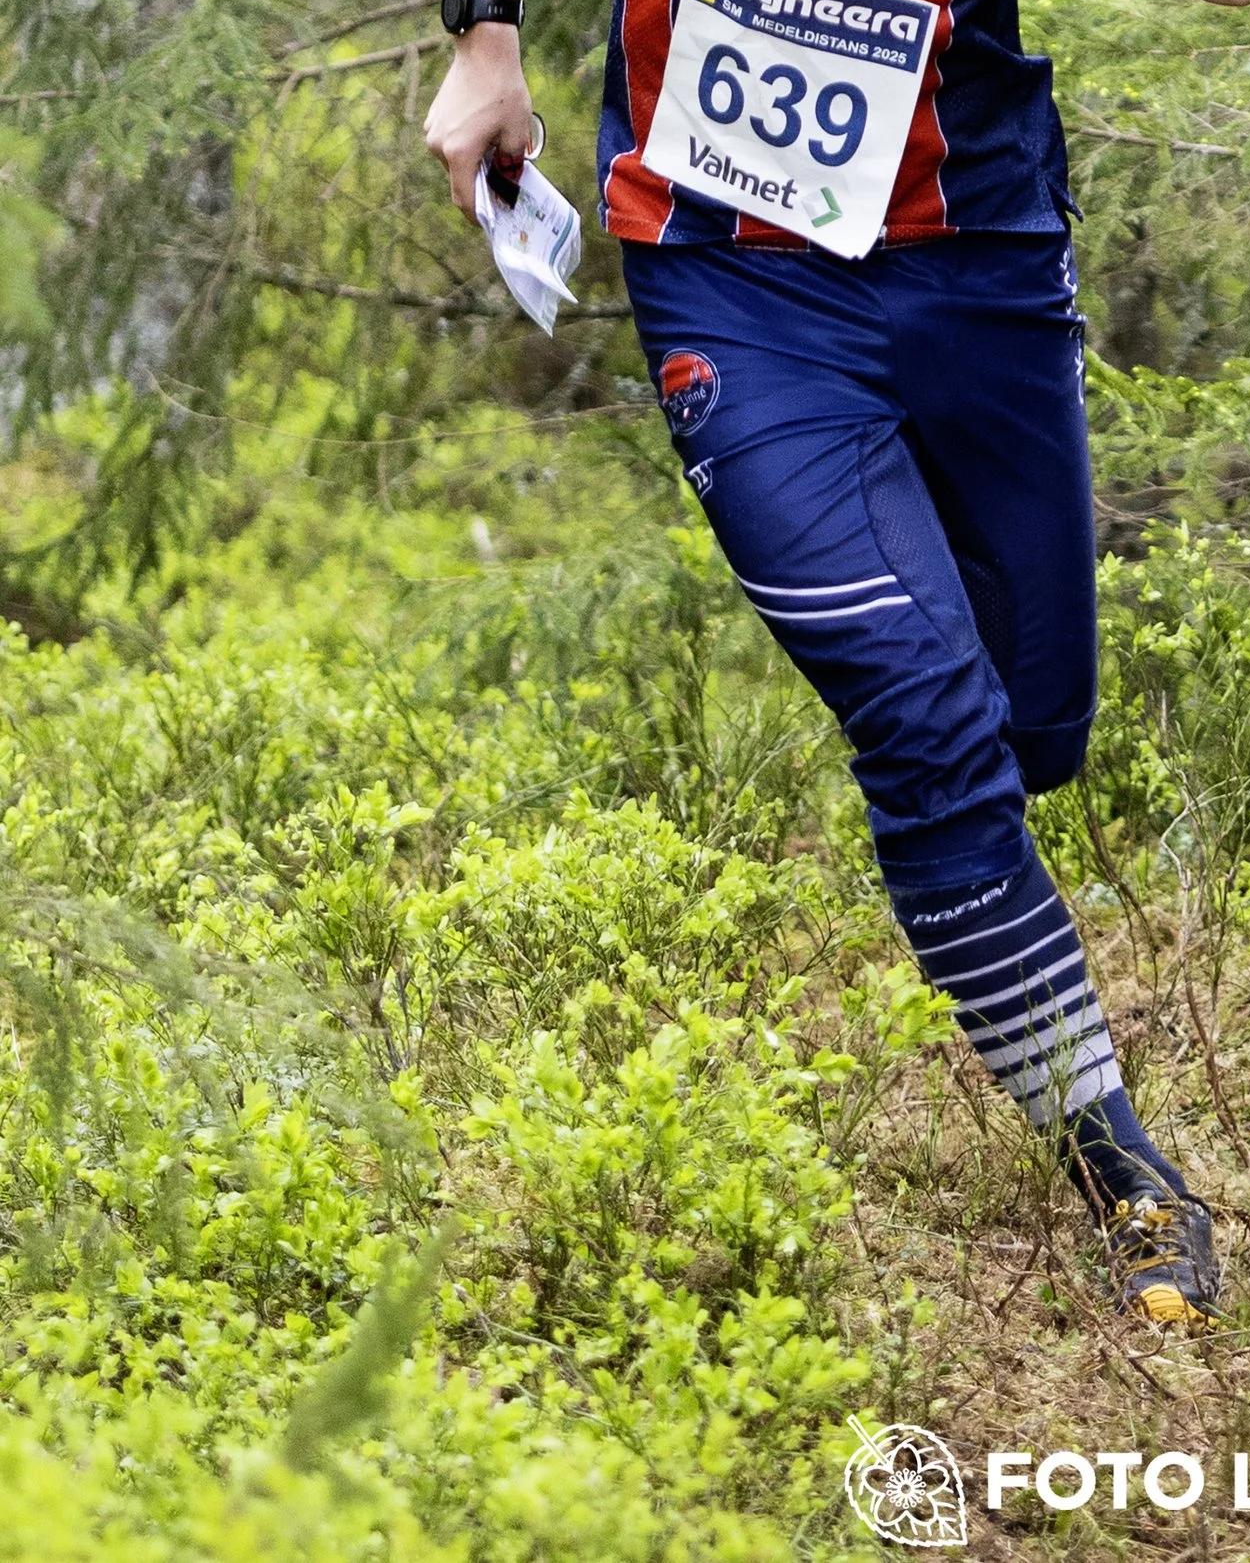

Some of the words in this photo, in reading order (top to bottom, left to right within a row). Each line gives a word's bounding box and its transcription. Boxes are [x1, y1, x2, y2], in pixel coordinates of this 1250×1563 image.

[751, 13, 869, 57] MEDELDISTANS
[871, 45, 908, 65] 2025
[698, 42, 869, 168] 639
[688, 133, 799, 210] Valmet
